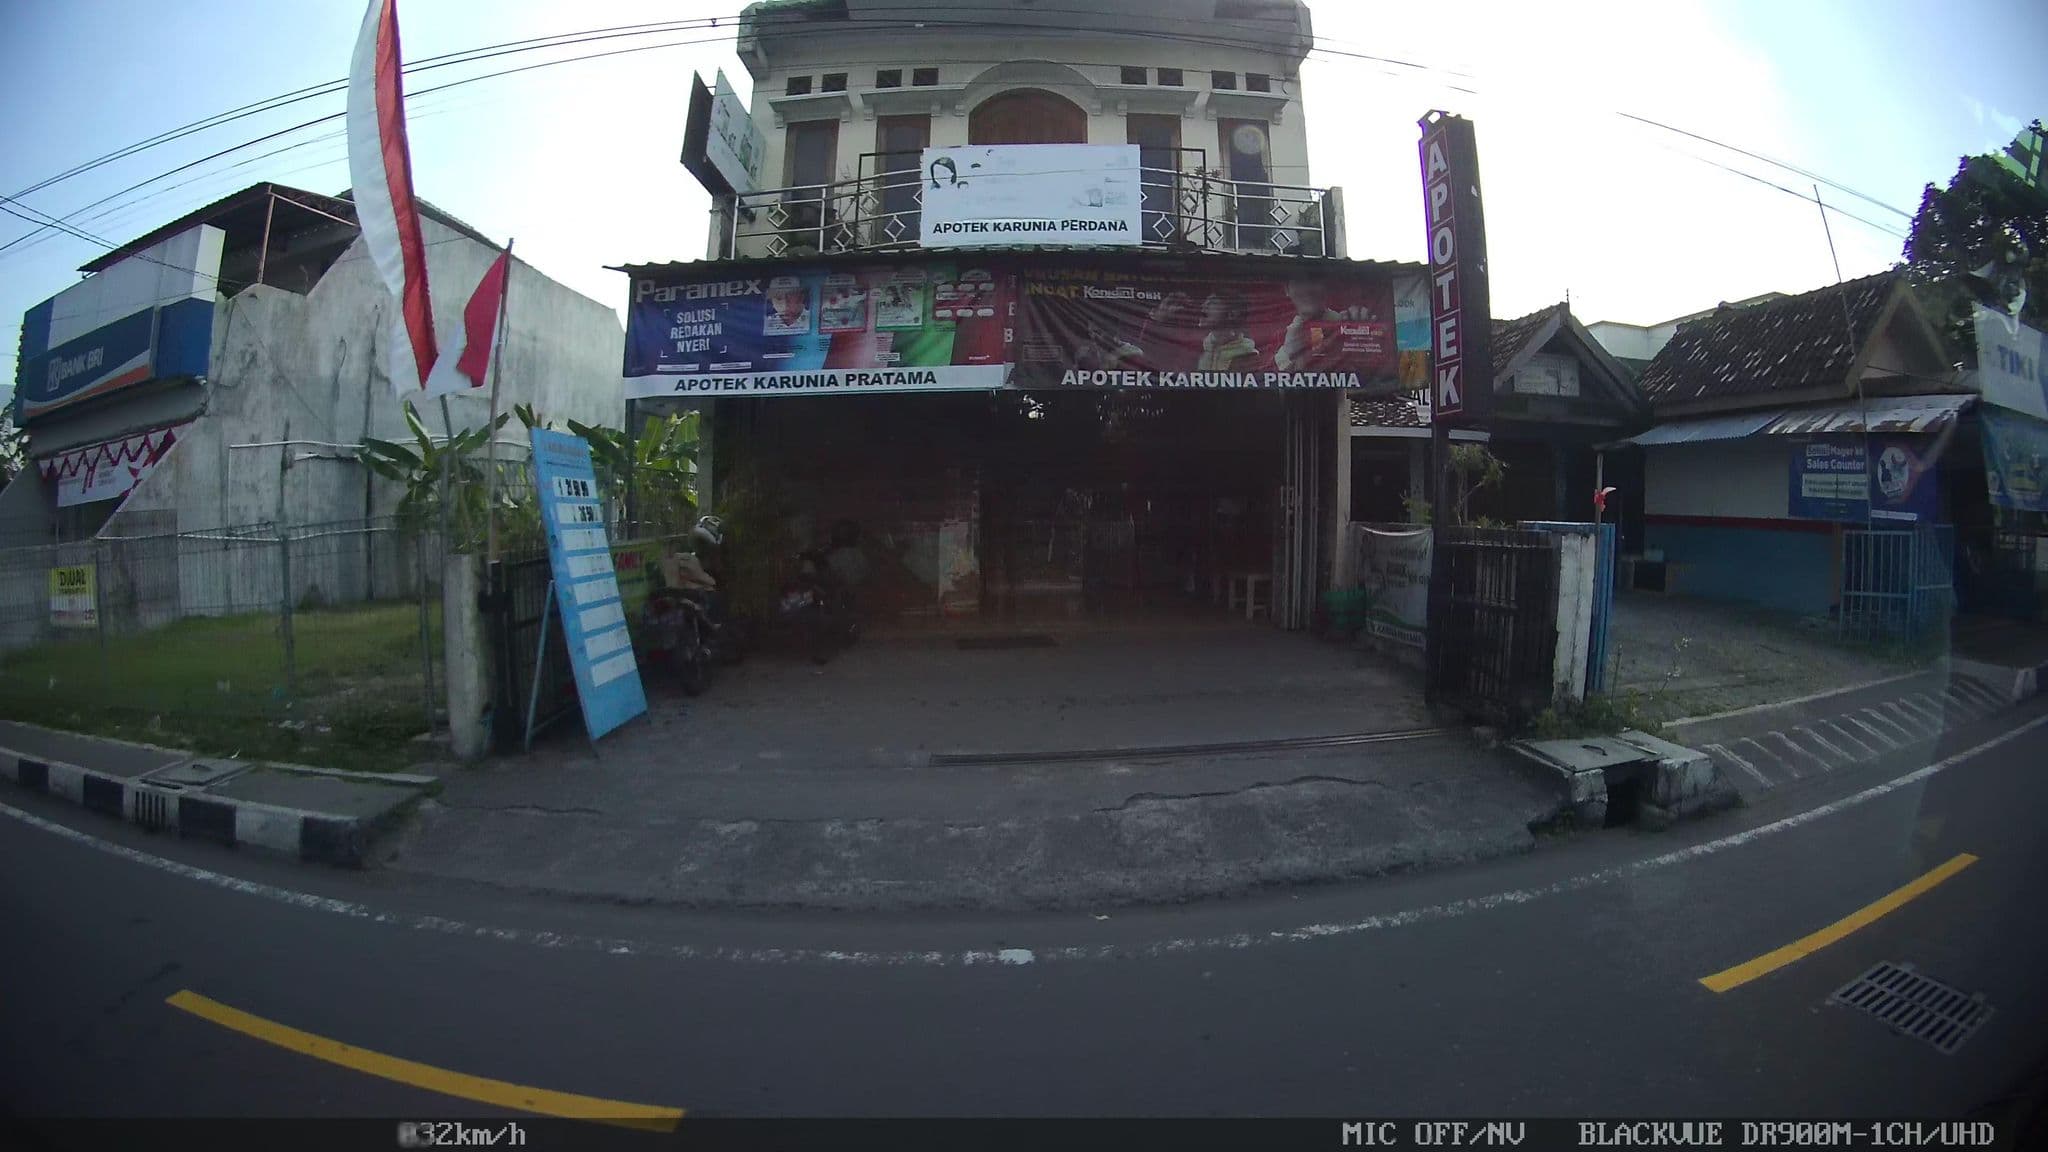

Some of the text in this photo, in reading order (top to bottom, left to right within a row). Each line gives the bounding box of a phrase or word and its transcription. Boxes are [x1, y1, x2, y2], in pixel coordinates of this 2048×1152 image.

[933, 219, 1127, 234] APOTEK KARUNIA PERDANA
[1427, 141, 1460, 408] APOTEK
[635, 277, 764, 304] Paramex
[676, 308, 716, 324] SOLUSI
[670, 323, 723, 340] REDAKAN
[676, 339, 710, 353] NYERI
[60, 346, 104, 380] BANK BRI
[675, 370, 938, 392] APOTEK KARUNIA PRATAMA
[1061, 370, 1361, 389] APOTEK KARUNIA PRATAMA
